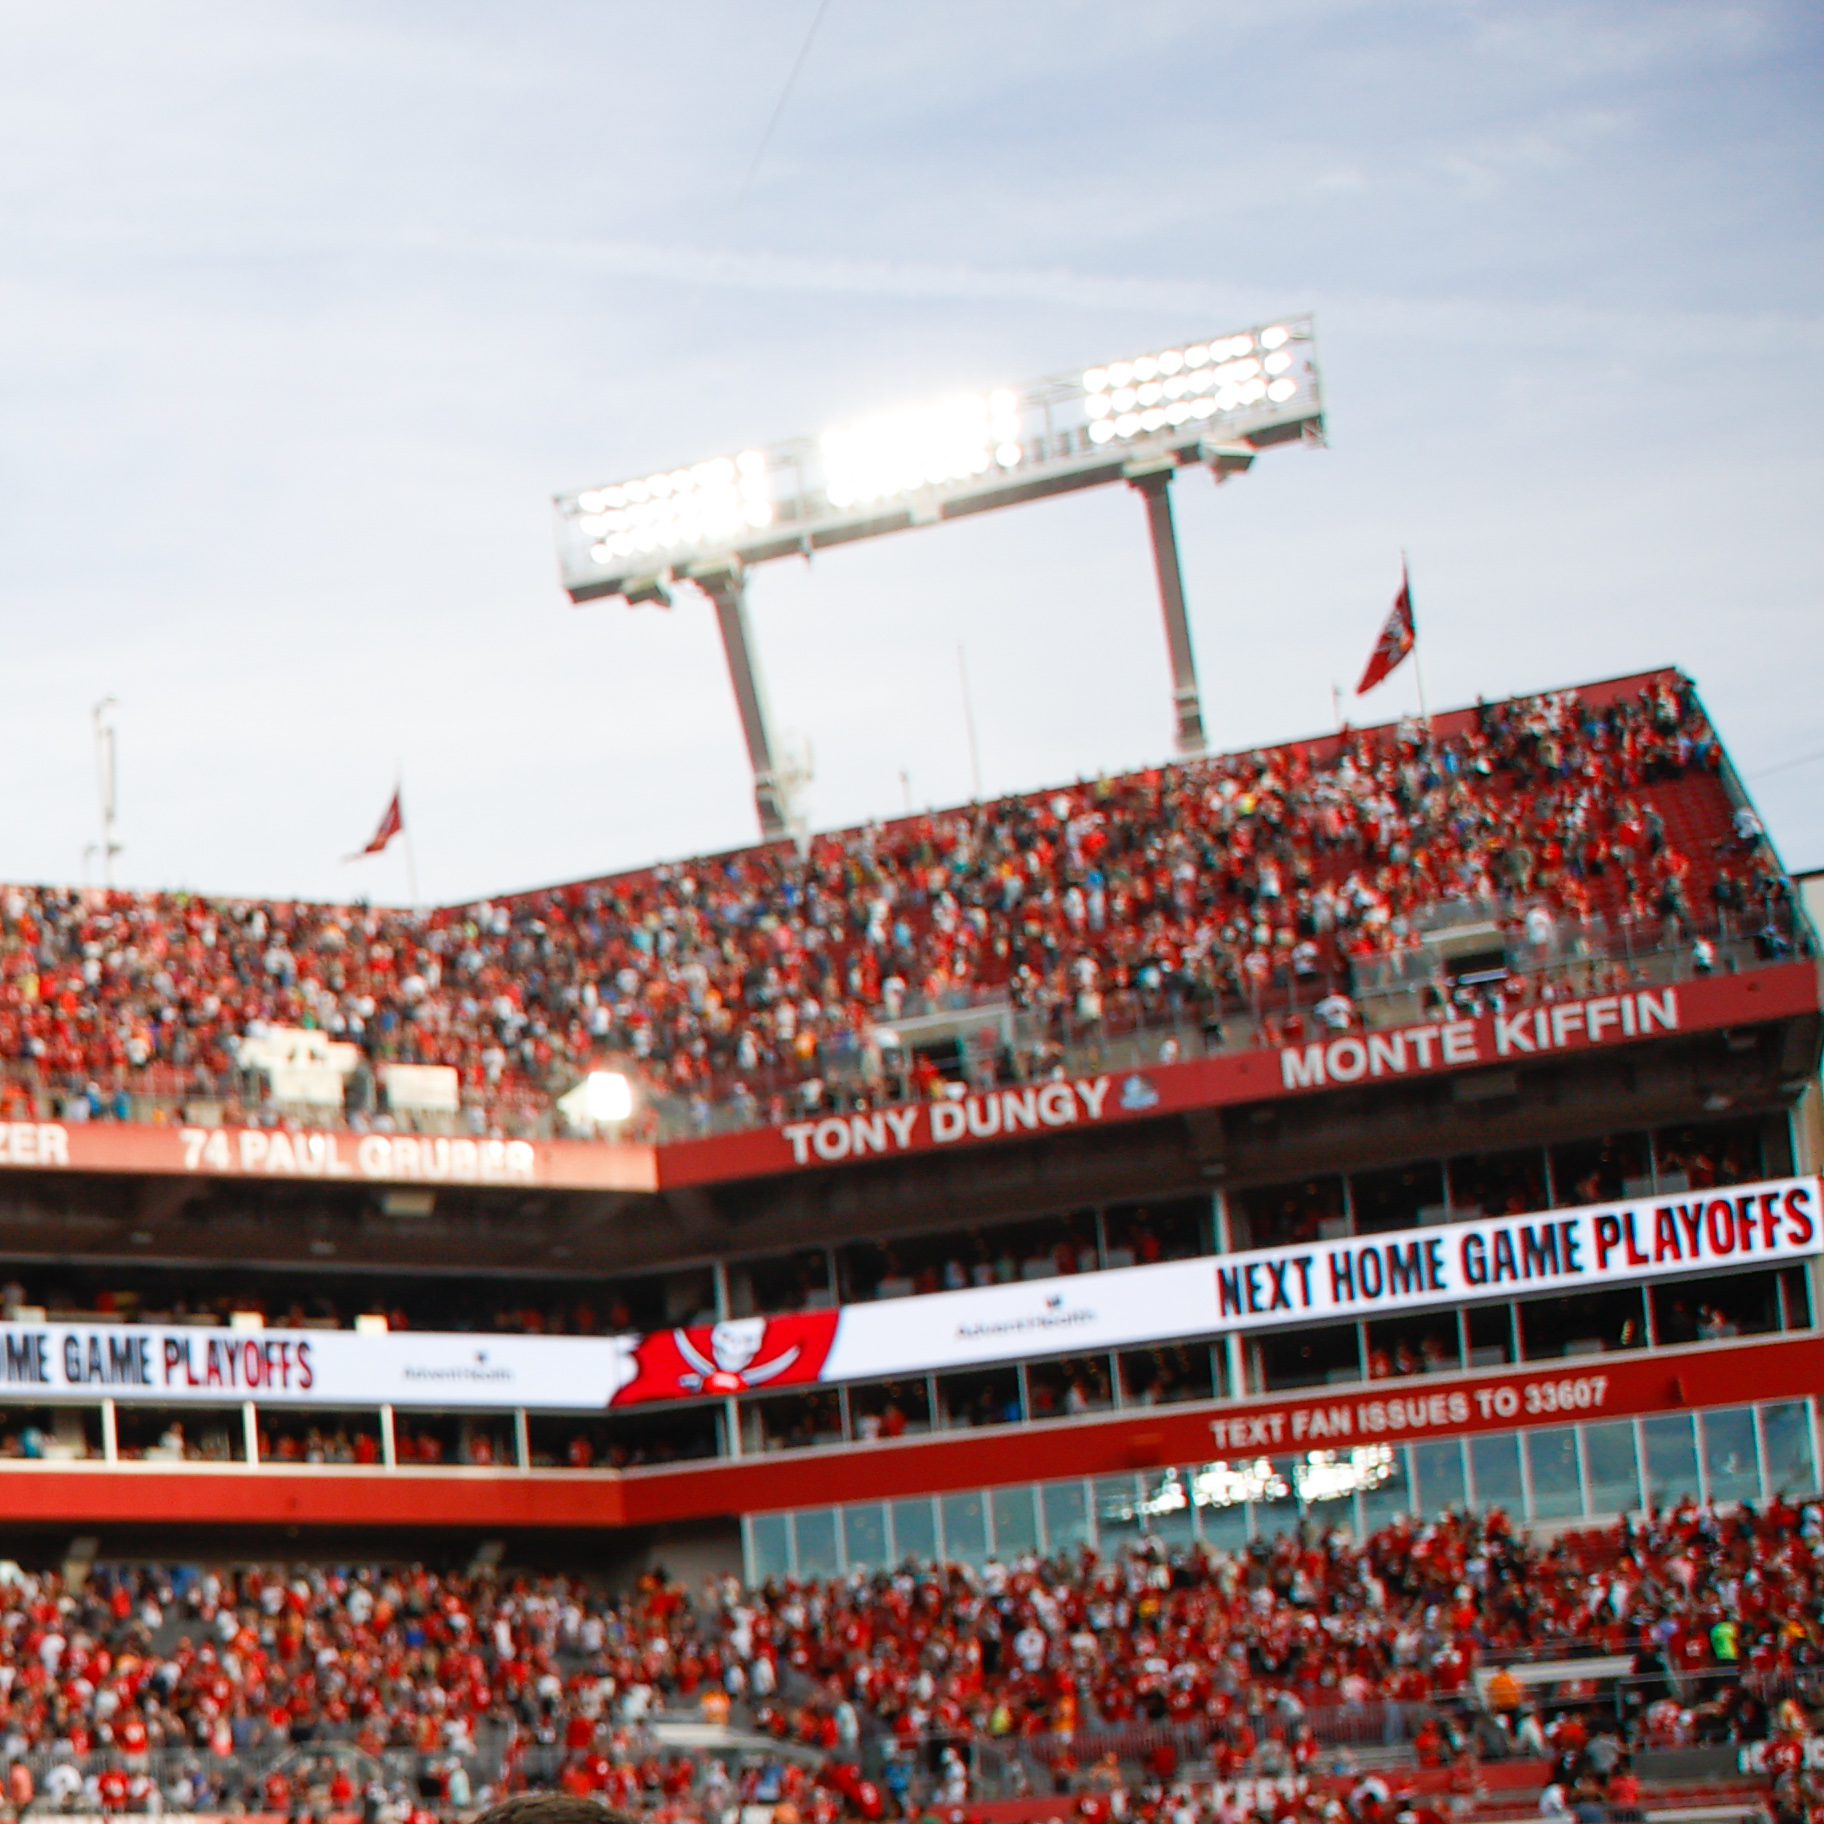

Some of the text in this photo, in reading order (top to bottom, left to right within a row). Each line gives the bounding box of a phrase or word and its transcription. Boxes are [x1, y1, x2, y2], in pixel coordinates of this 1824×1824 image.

[1279, 989, 1680, 1090] MONTE KIFFIN
[180, 1129, 536, 1179] 74 PAUL GRUBER
[783, 1075, 1112, 1164] TONY DUNGY
[1217, 1187, 1814, 1319] NEXT HOME GAME PLAYOFFS
[64, 1334, 150, 1387] GAME
[163, 1336, 313, 1389] PLAYOFFS
[1210, 1375, 1608, 1449] TEXT FAN ISSUES TO 33607
